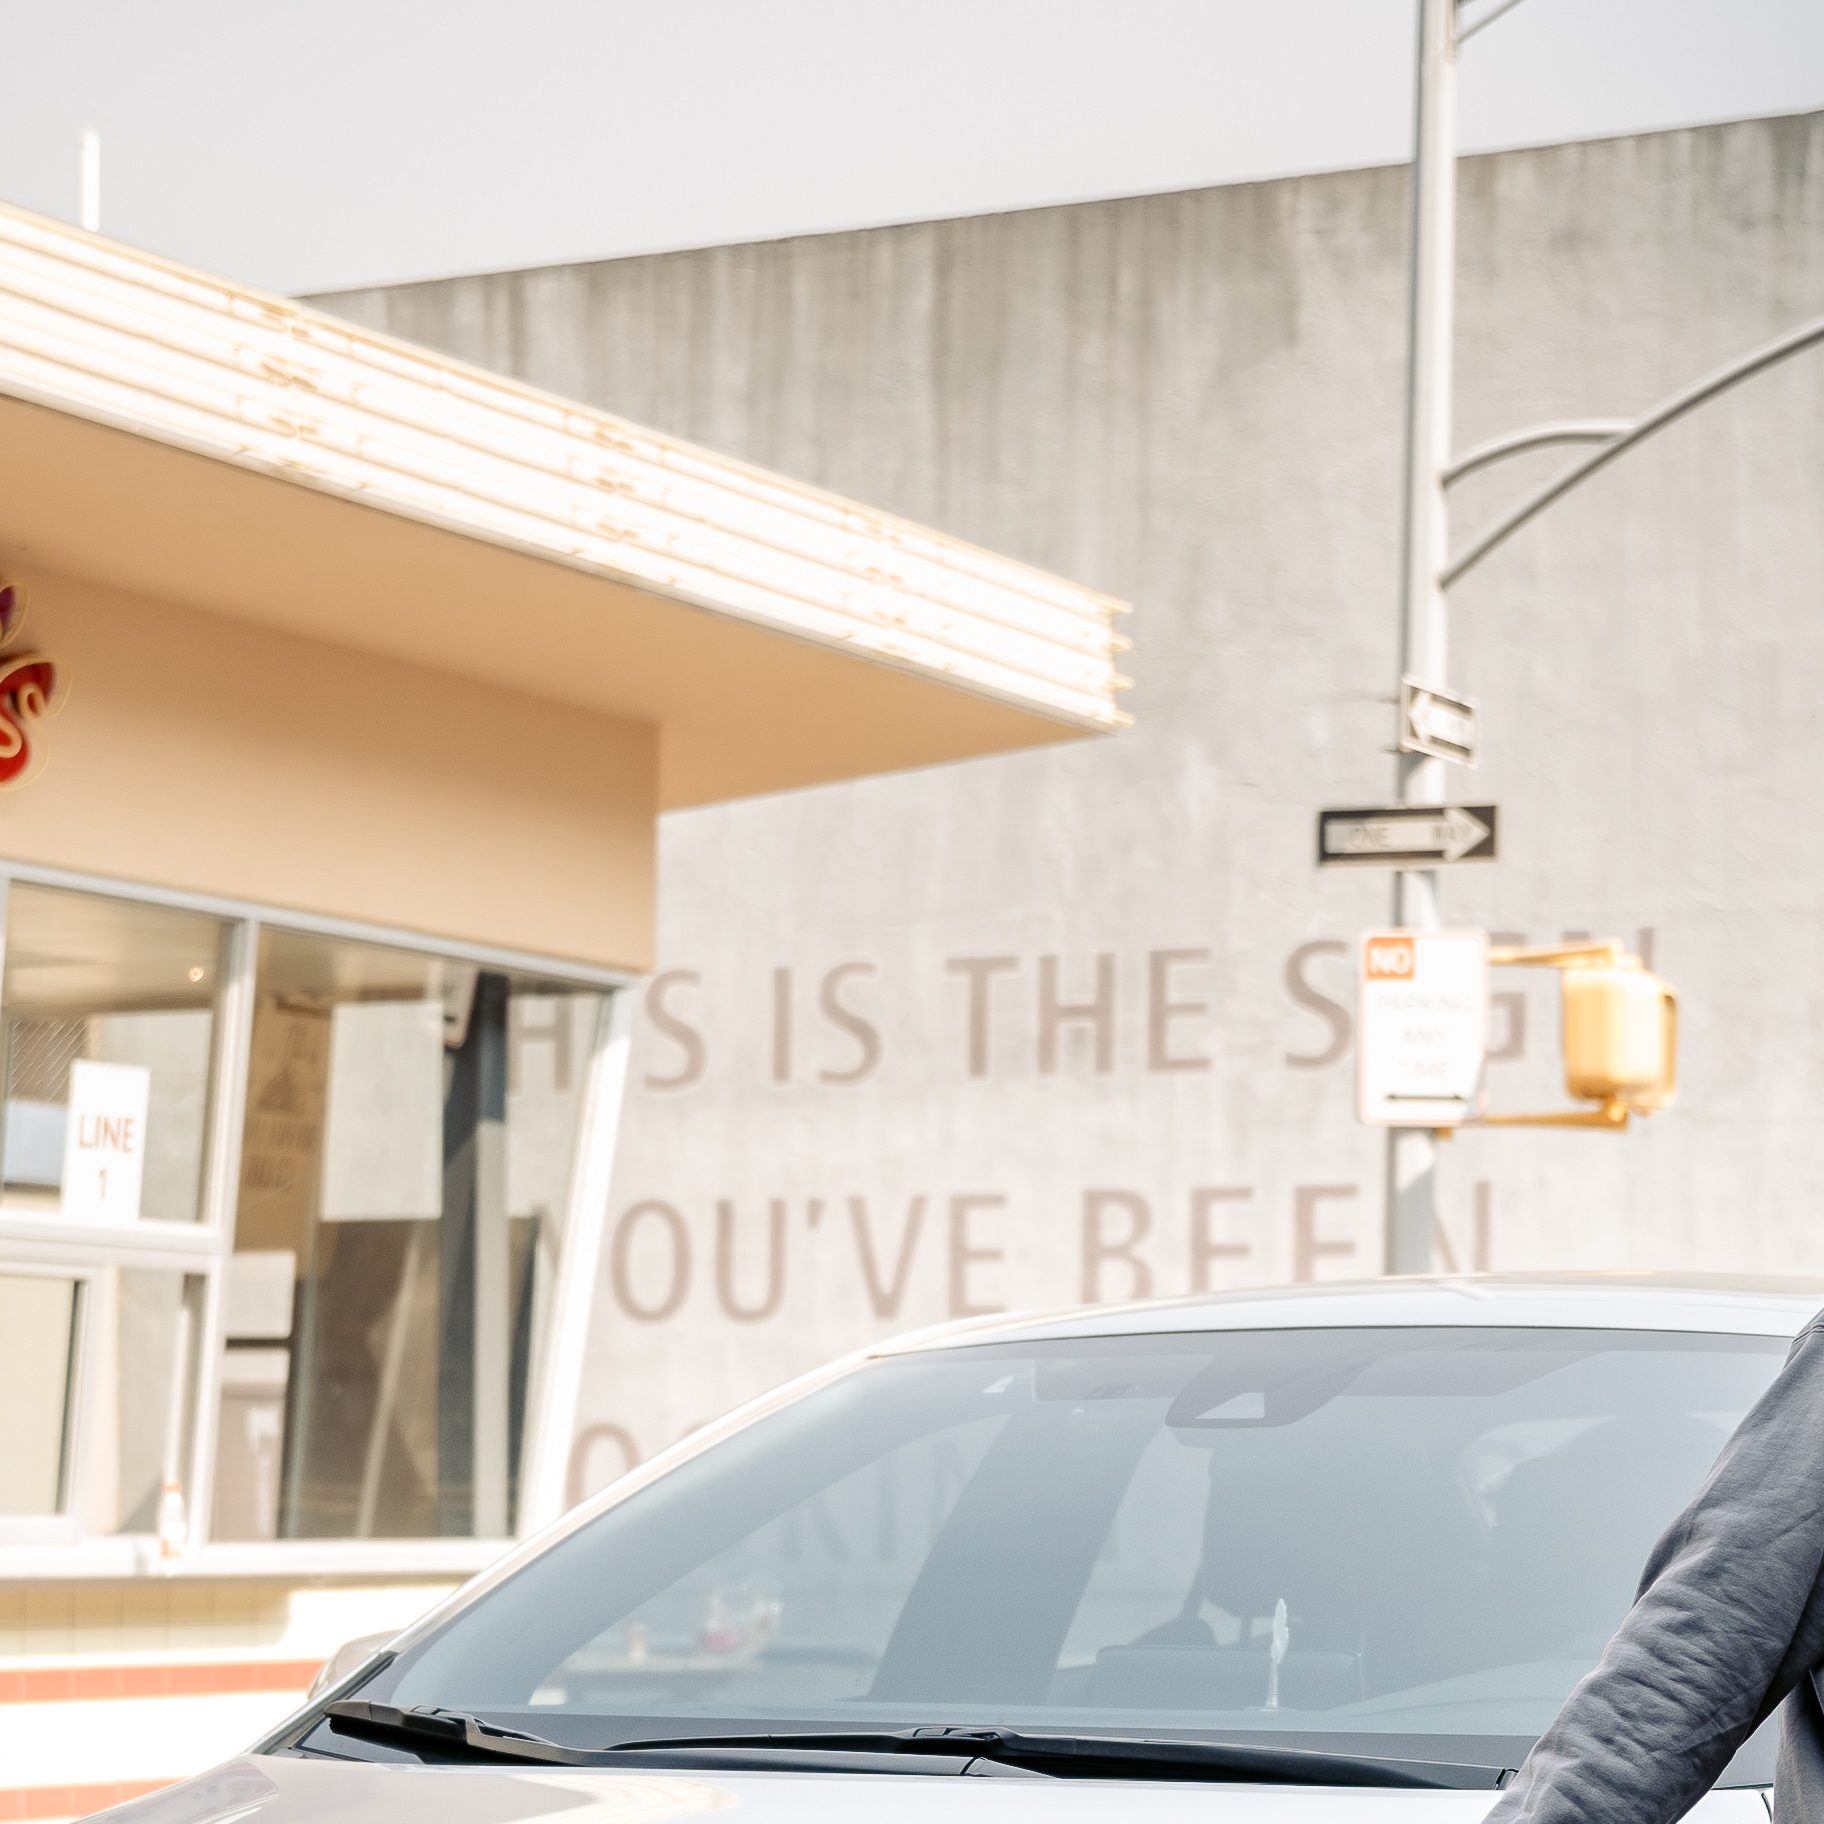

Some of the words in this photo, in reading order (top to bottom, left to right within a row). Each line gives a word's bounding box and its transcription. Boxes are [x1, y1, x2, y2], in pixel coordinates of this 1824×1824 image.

[1369, 946, 1412, 976] NO
[773, 961, 884, 1086] IS
[948, 947, 1214, 1081] THE
[79, 1113, 134, 1153] LINE
[99, 1168, 107, 1200] 1
